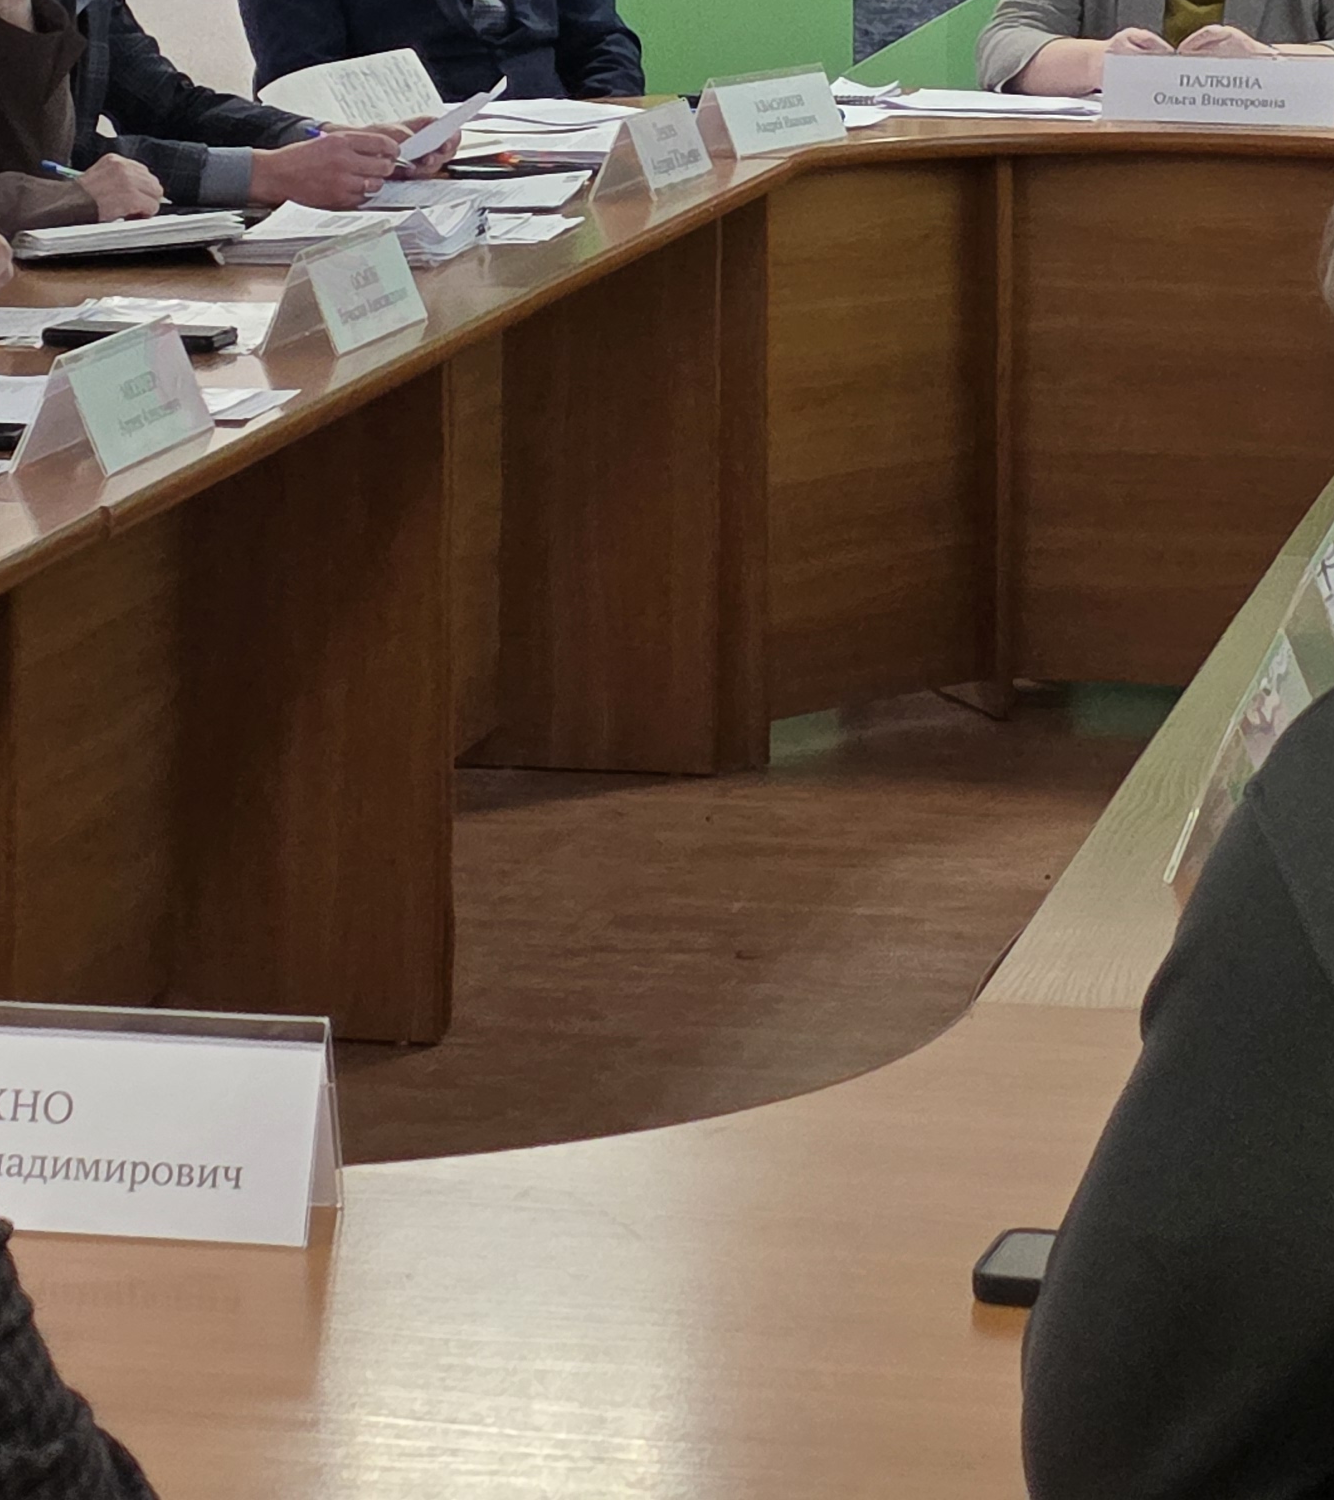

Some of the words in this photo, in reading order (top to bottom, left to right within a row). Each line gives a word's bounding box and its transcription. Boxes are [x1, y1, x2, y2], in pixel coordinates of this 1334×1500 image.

[1179, 74, 1262, 90] ПАЛКИНА
[1153, 91, 1196, 106] Ольга
[1201, 92, 1286, 110] Викторовна
